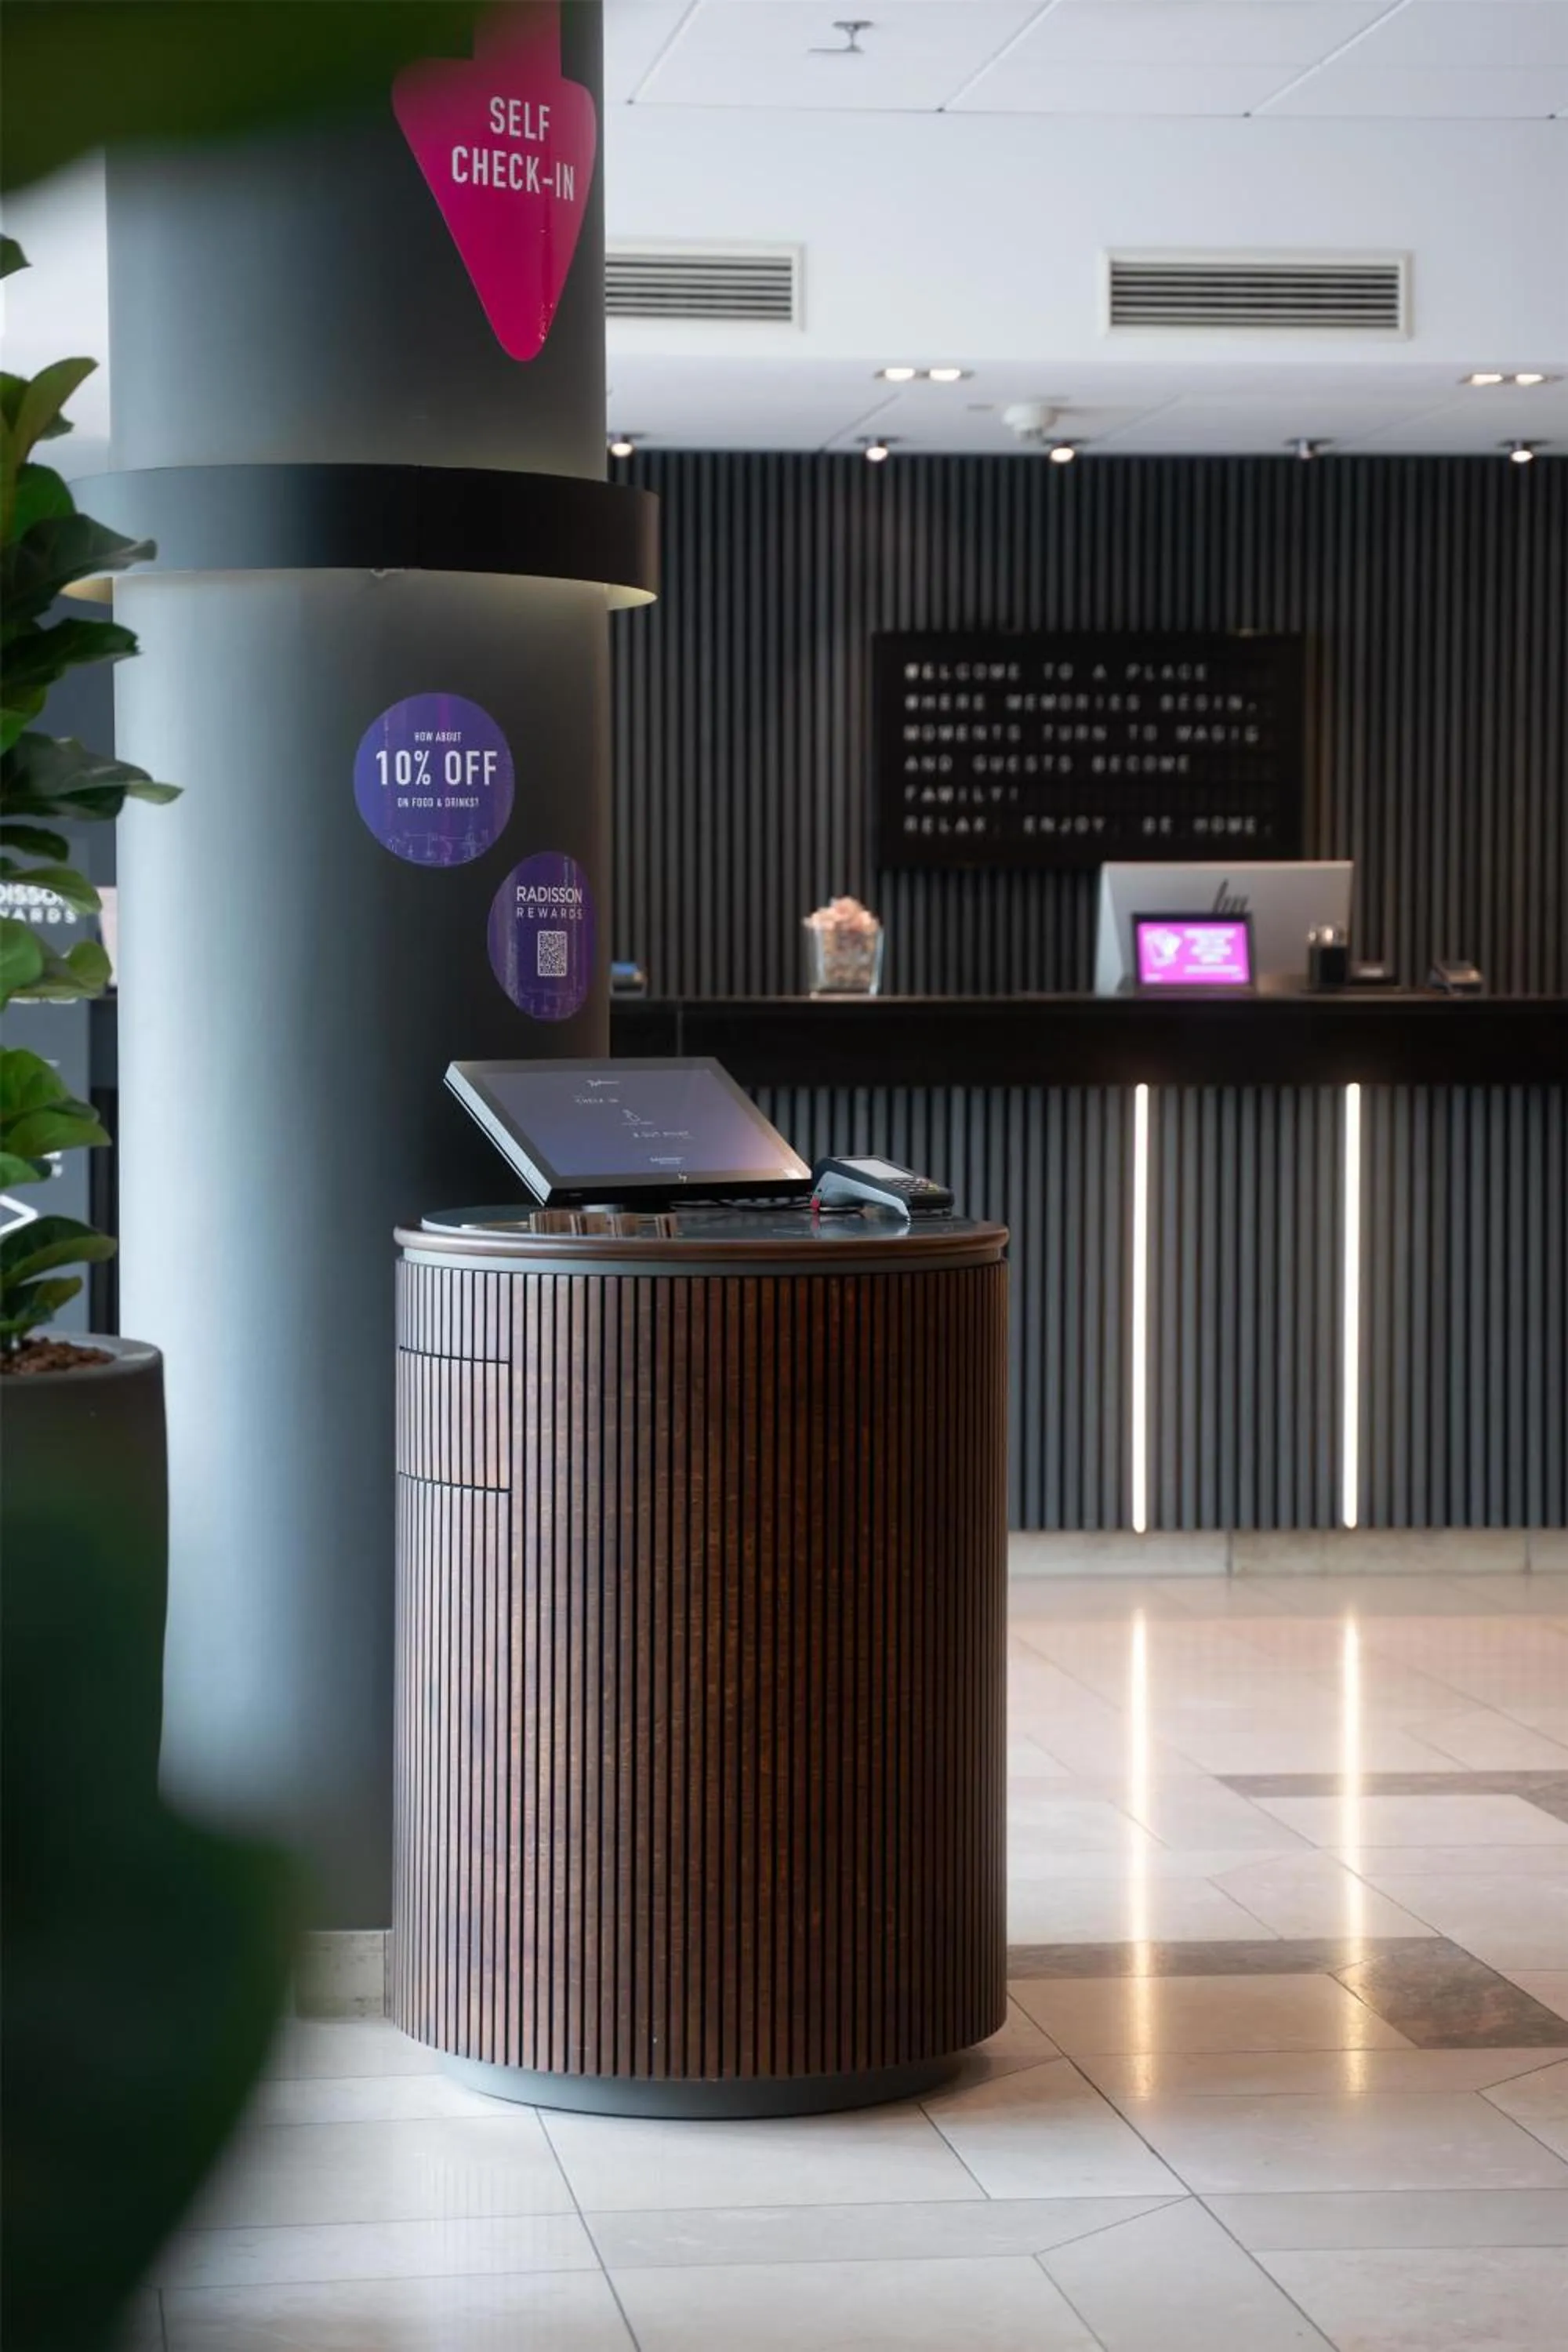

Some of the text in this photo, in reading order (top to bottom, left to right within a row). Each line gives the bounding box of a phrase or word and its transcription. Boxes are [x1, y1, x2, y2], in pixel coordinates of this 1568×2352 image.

[490, 96, 550, 142] SELF
[452, 145, 574, 201] CHECK-IN
[904, 662, 1207, 681] WELCOME TO A PLACE
[904, 694, 985, 711] WHERE
[1005, 693, 1140, 711] MEMORIES
[414, 731, 462, 742] HOW ABOUT
[903, 724, 1259, 742] MOMENTS TURN TO MAGIC
[376, 750, 498, 786] 10% OFF
[904, 754, 1189, 773] AND GUESTS BECOME
[397, 797, 479, 808] ON FOOD & DRINKS?
[517, 886, 583, 903] RADISSON
[517, 907, 583, 920] REWARDS
